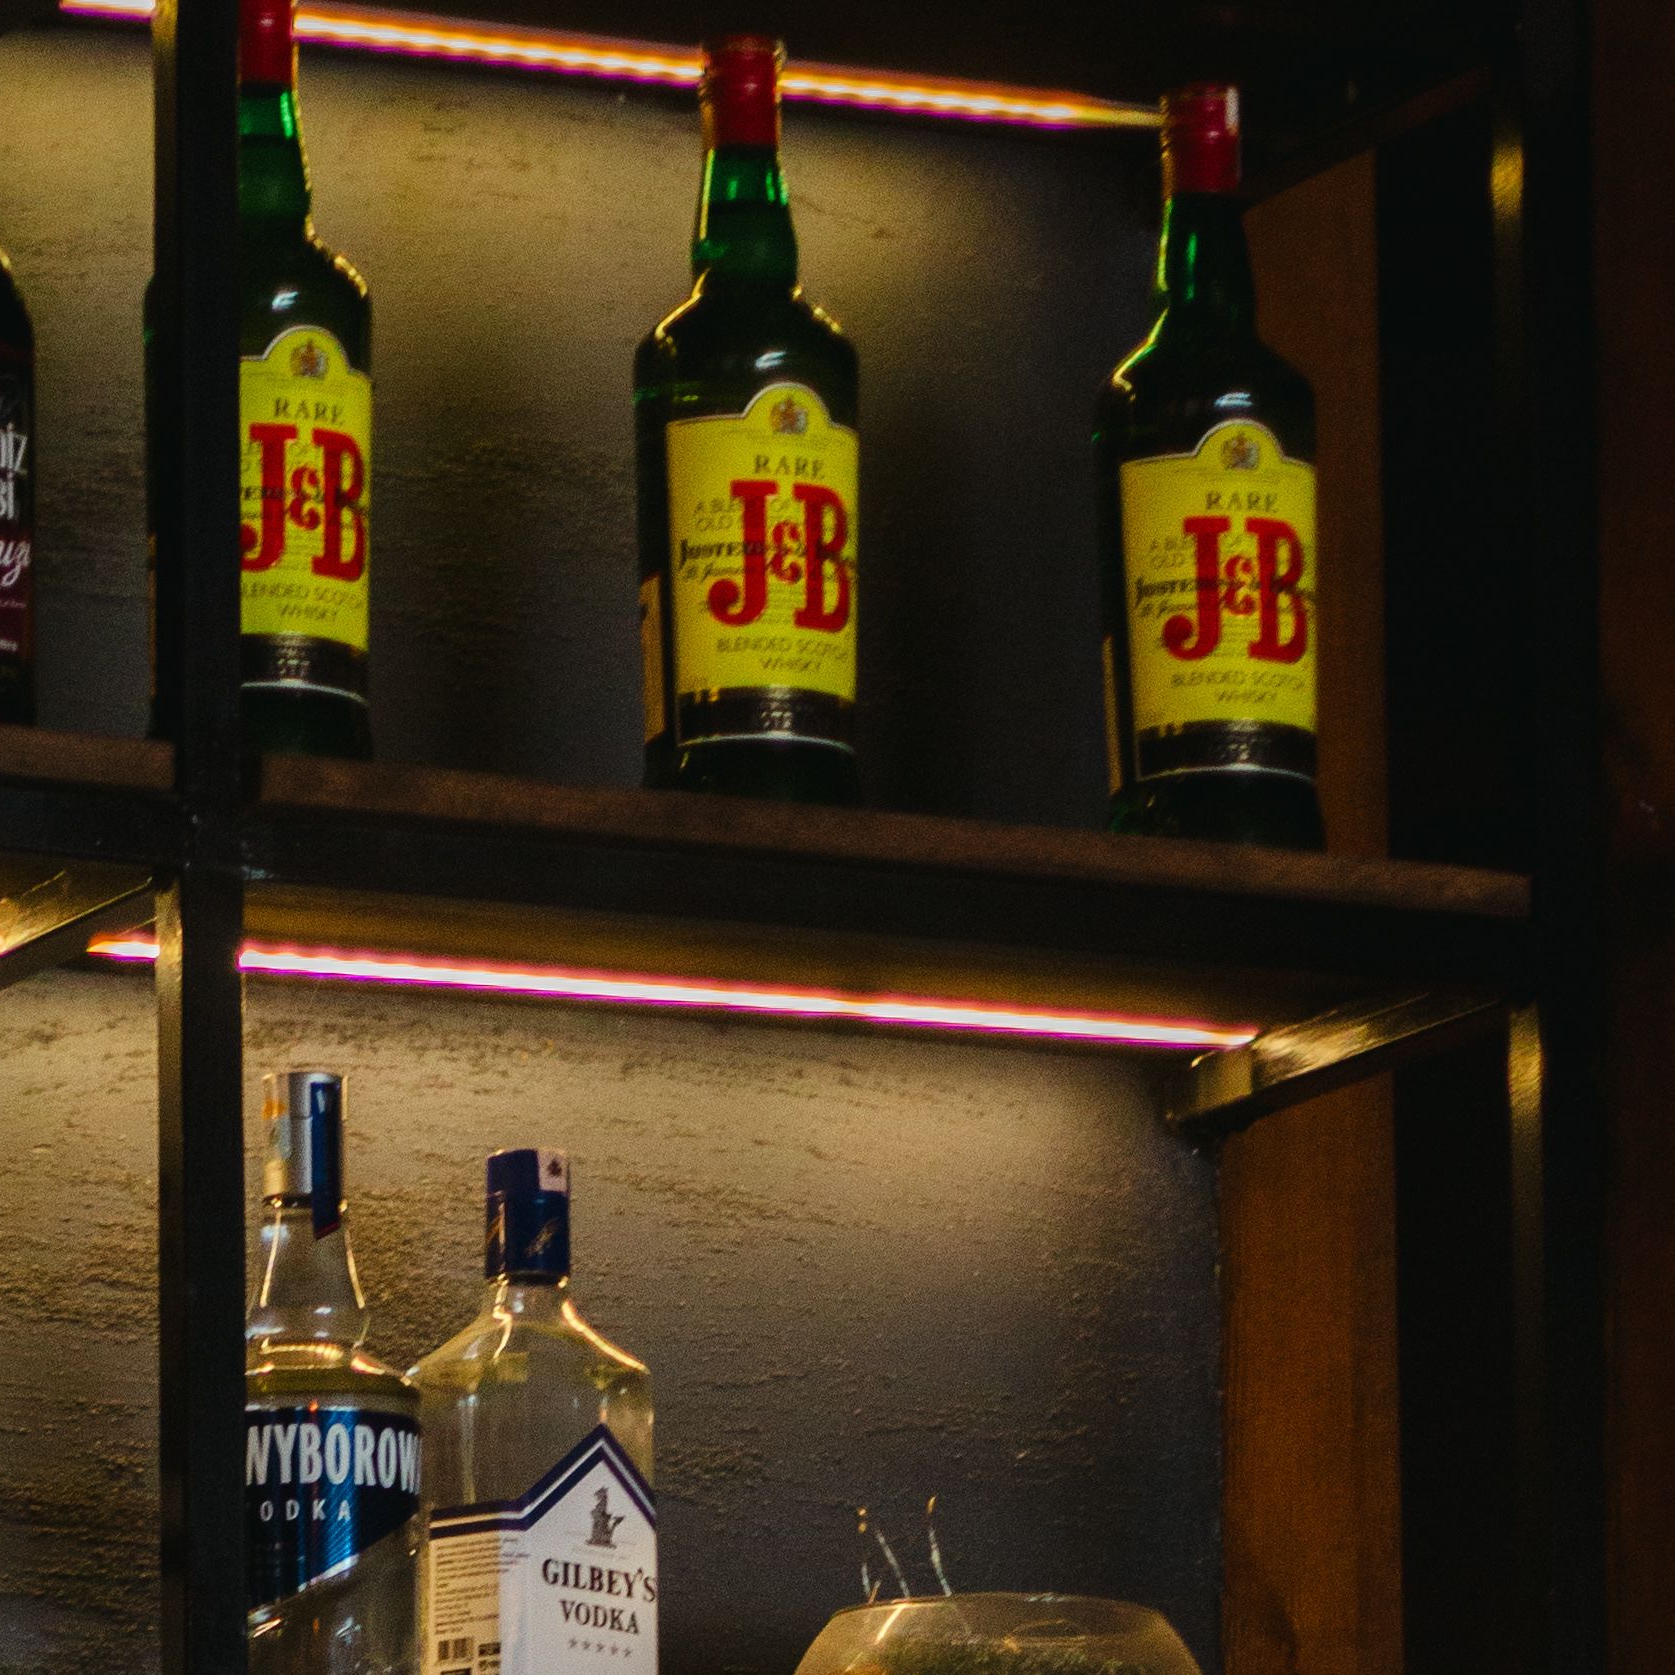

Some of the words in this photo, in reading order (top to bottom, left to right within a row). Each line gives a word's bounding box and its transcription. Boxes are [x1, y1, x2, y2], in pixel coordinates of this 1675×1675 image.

[754, 453, 826, 481] RARE
[239, 421, 366, 583] J&B
[1205, 491, 1279, 513] RARE
[708, 480, 851, 635] J&B
[1161, 516, 1308, 665] J&B
[541, 1557, 658, 1603] GILBEY'S
[559, 1599, 641, 1635] VODKA
